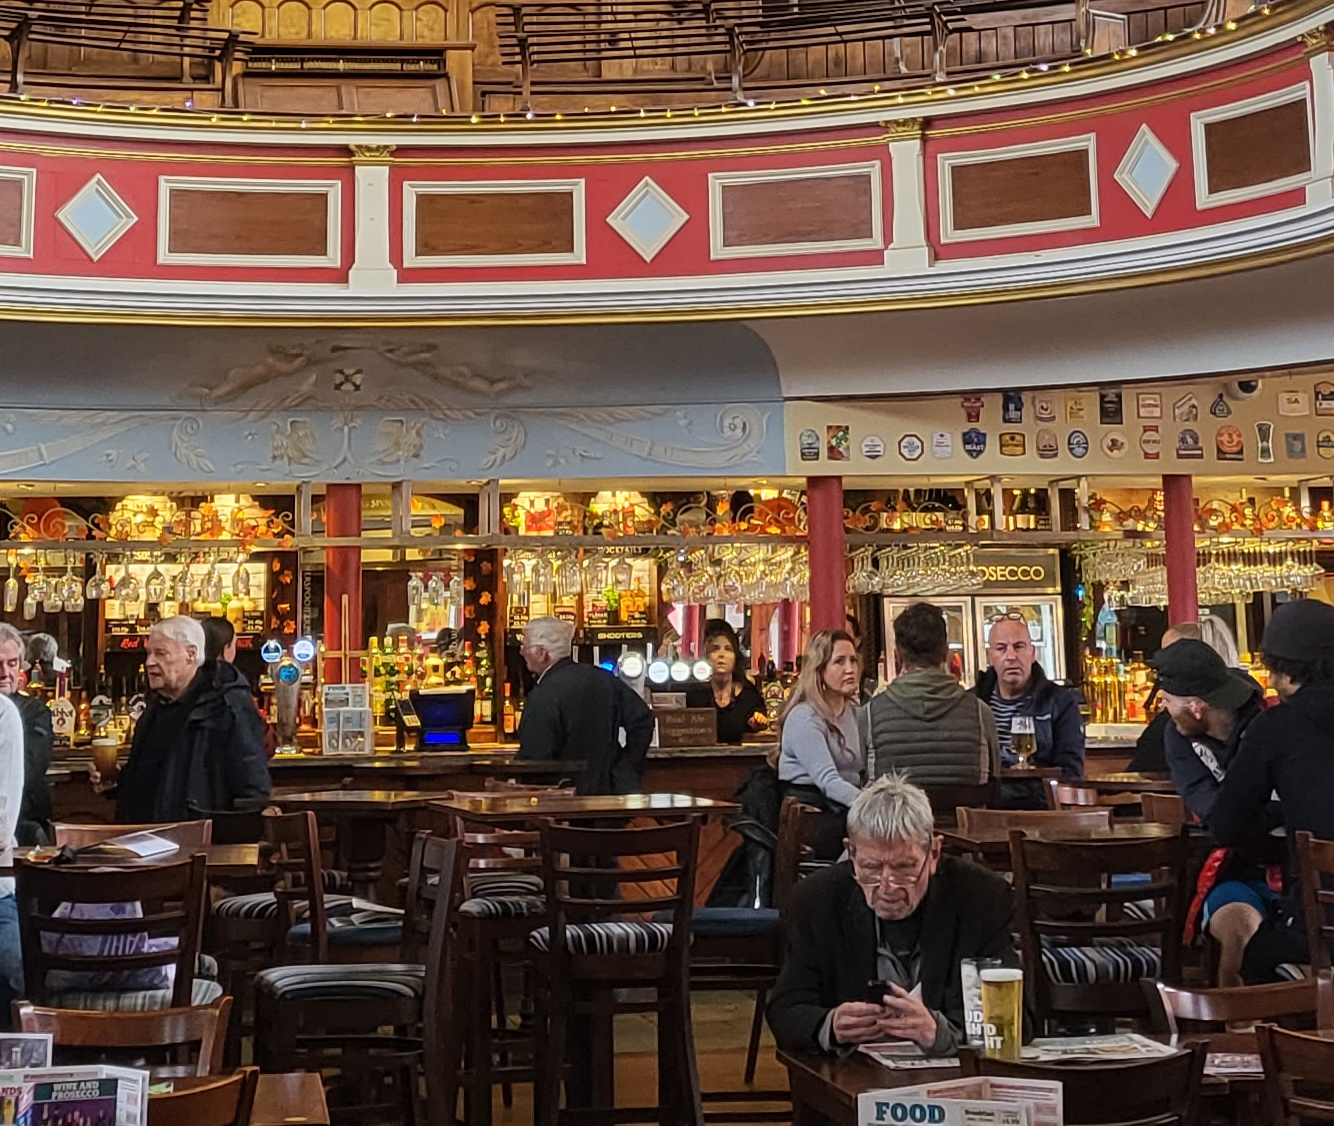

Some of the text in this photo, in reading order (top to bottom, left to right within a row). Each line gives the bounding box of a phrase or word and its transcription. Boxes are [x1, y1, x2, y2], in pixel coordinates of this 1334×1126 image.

[980, 566, 1045, 581] OSECCO
[597, 632, 643, 640] SHOOTERS
[53, 1081, 99, 1091] WINE AND
[51, 1089, 100, 1100] PROSECCO
[874, 1102, 946, 1124] FOOD
